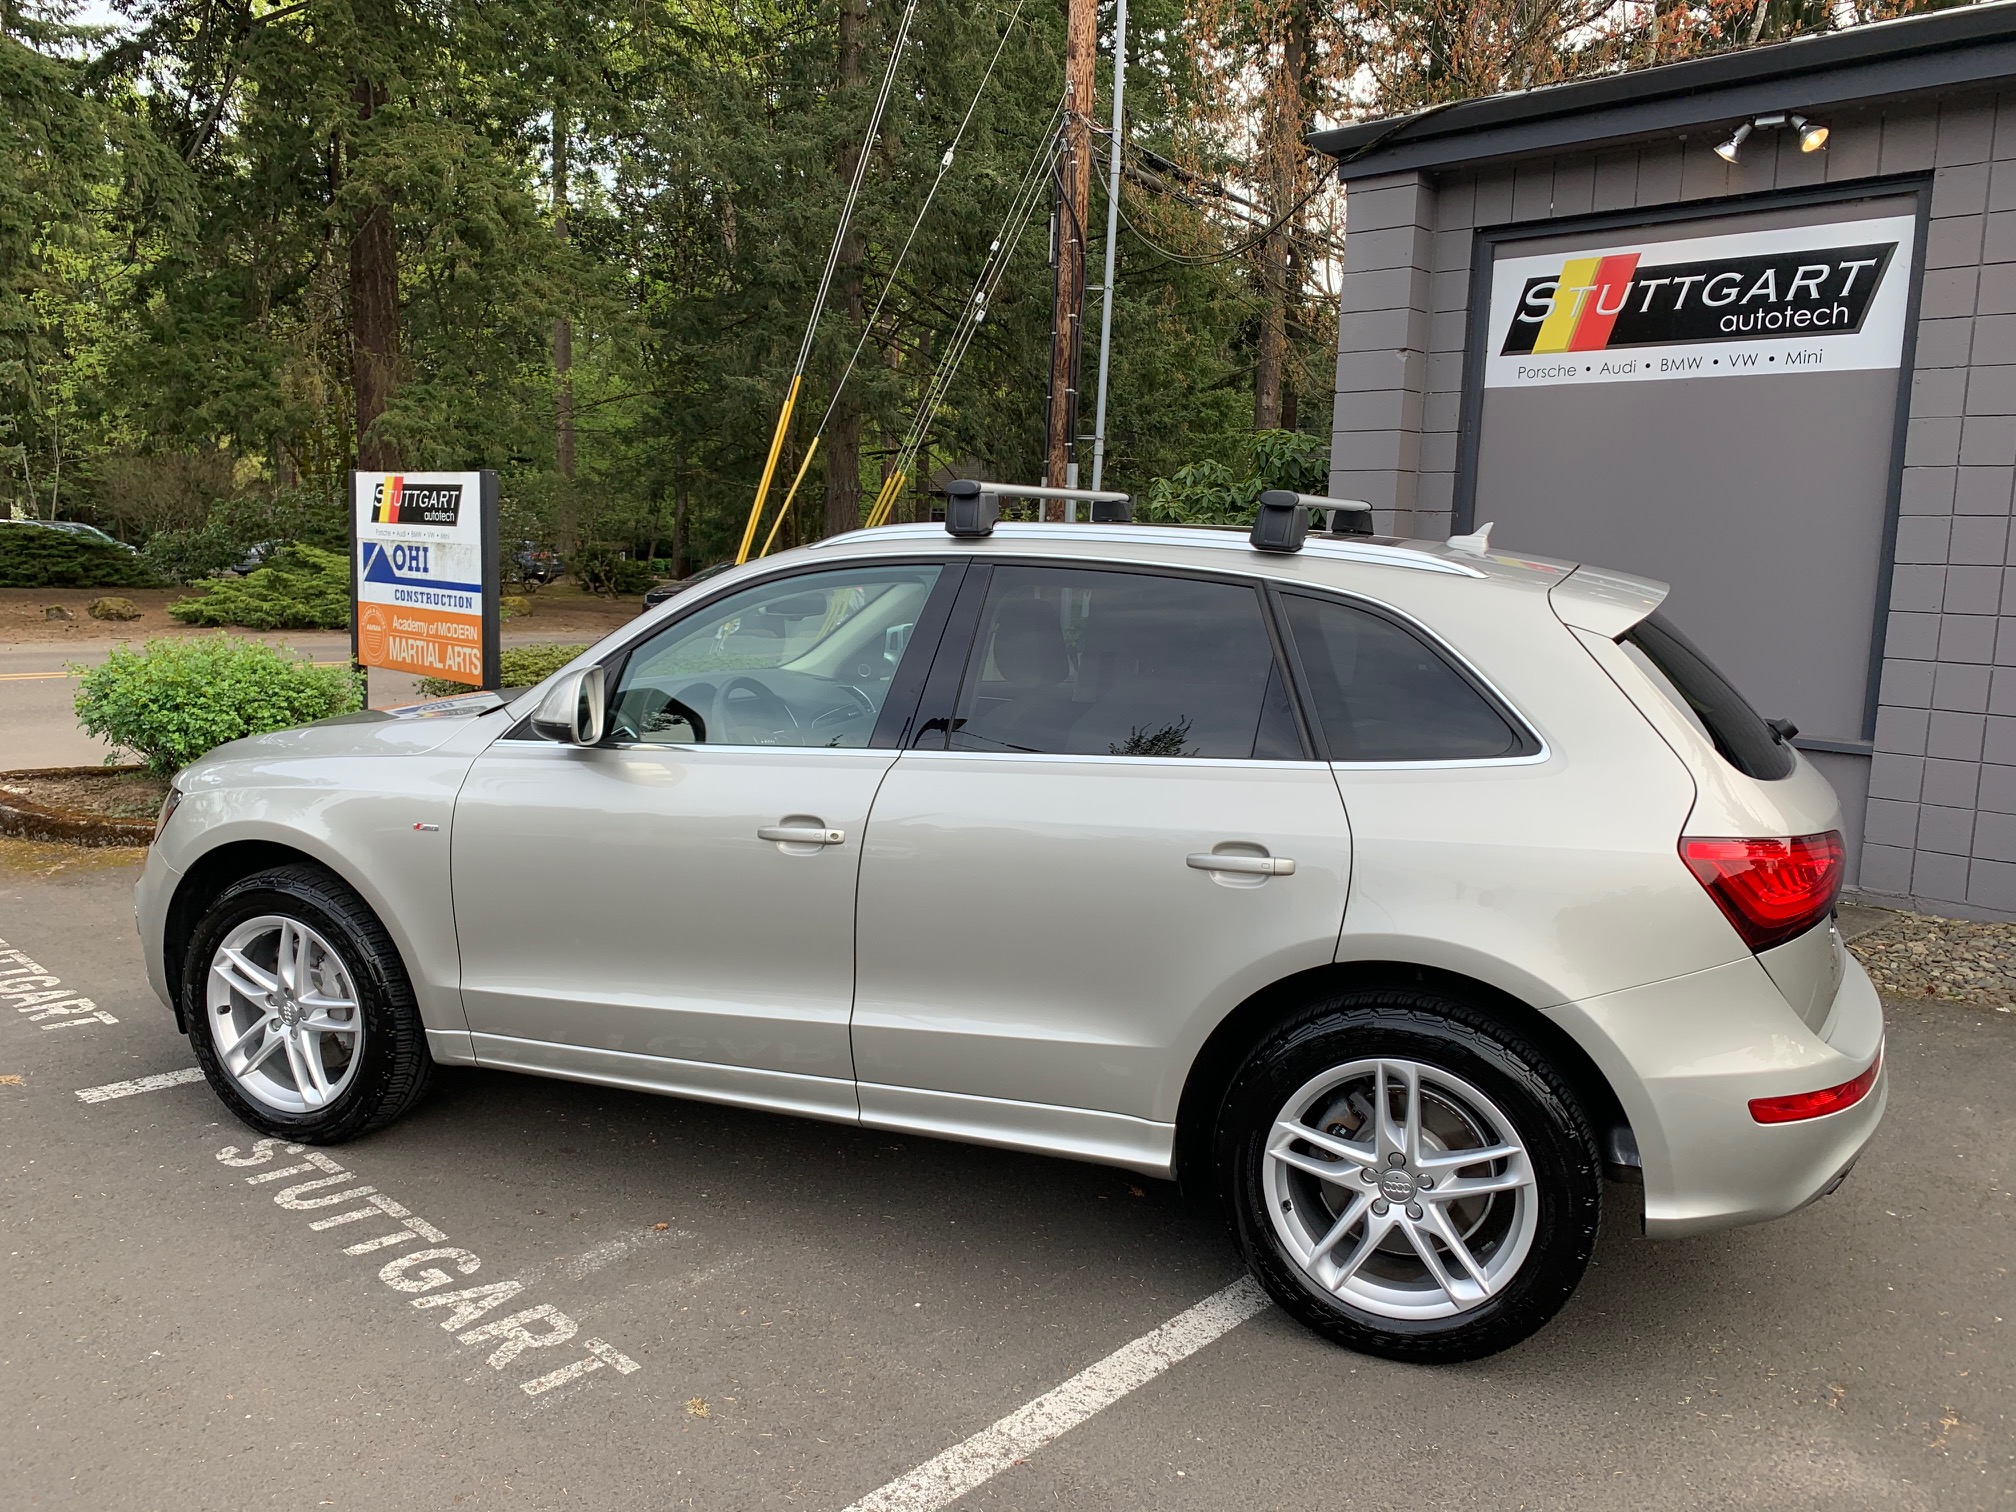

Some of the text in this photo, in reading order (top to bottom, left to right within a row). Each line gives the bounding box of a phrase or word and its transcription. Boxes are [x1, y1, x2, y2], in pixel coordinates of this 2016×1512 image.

[1516, 257, 1878, 324] STUTTGART
[1719, 302, 1849, 333] autotech
[1517, 348, 1823, 379] Porsche Audi BMW VW Mini
[374, 485, 460, 508] STUTTGART
[424, 510, 455, 522] autotech
[392, 544, 429, 573] OHI
[394, 589, 473, 610] CONSTRUCTION
[392, 614, 428, 636] Academy
[429, 622, 437, 635] of
[438, 622, 478, 640] MODERN
[389, 636, 481, 675] MARTIAL ARTS
[215, 1137, 642, 1396] STUTTGART
